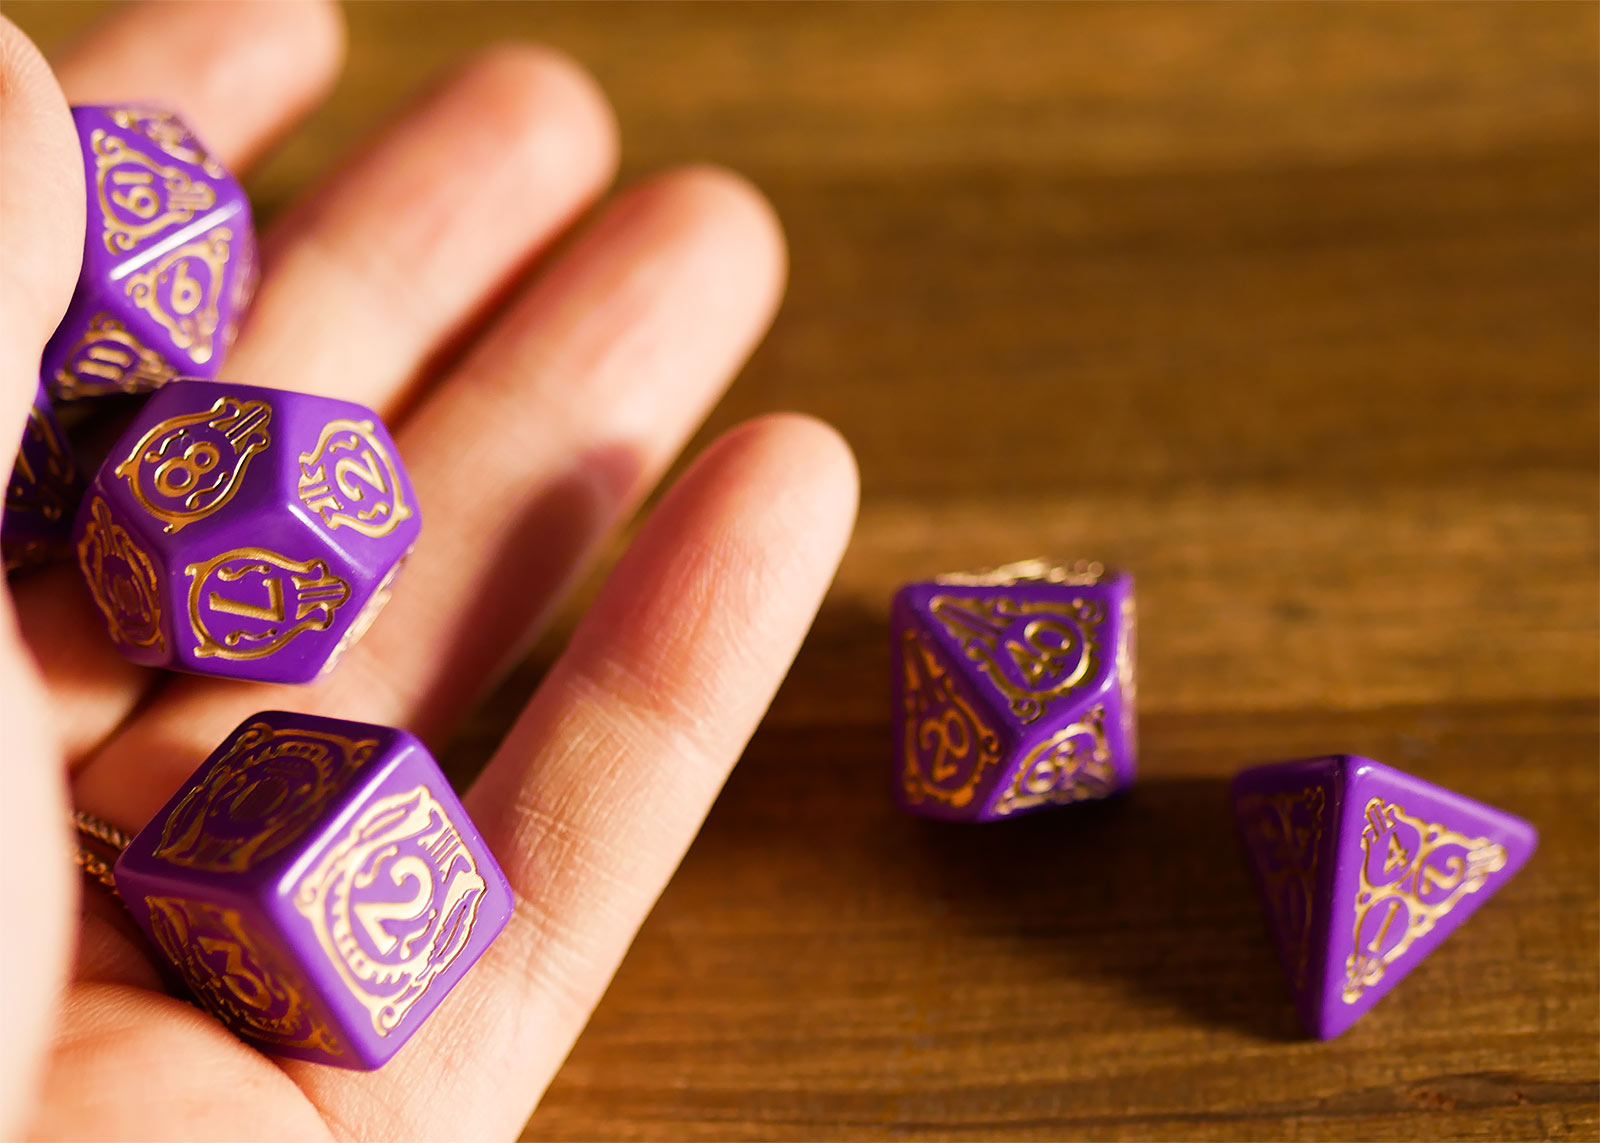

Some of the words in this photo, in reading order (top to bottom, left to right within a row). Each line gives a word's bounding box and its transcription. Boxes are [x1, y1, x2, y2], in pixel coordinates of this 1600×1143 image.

[77, 346, 131, 380] 11
[154, 441, 220, 497] 8
[335, 449, 388, 502] 2
[1004, 619, 1077, 688] 40
[919, 709, 969, 782] 20
[1384, 832, 1408, 874] 4
[1420, 856, 1465, 895] 2
[352, 856, 434, 956] 2
[1368, 900, 1399, 951] 1
[197, 936, 272, 1011] 3
